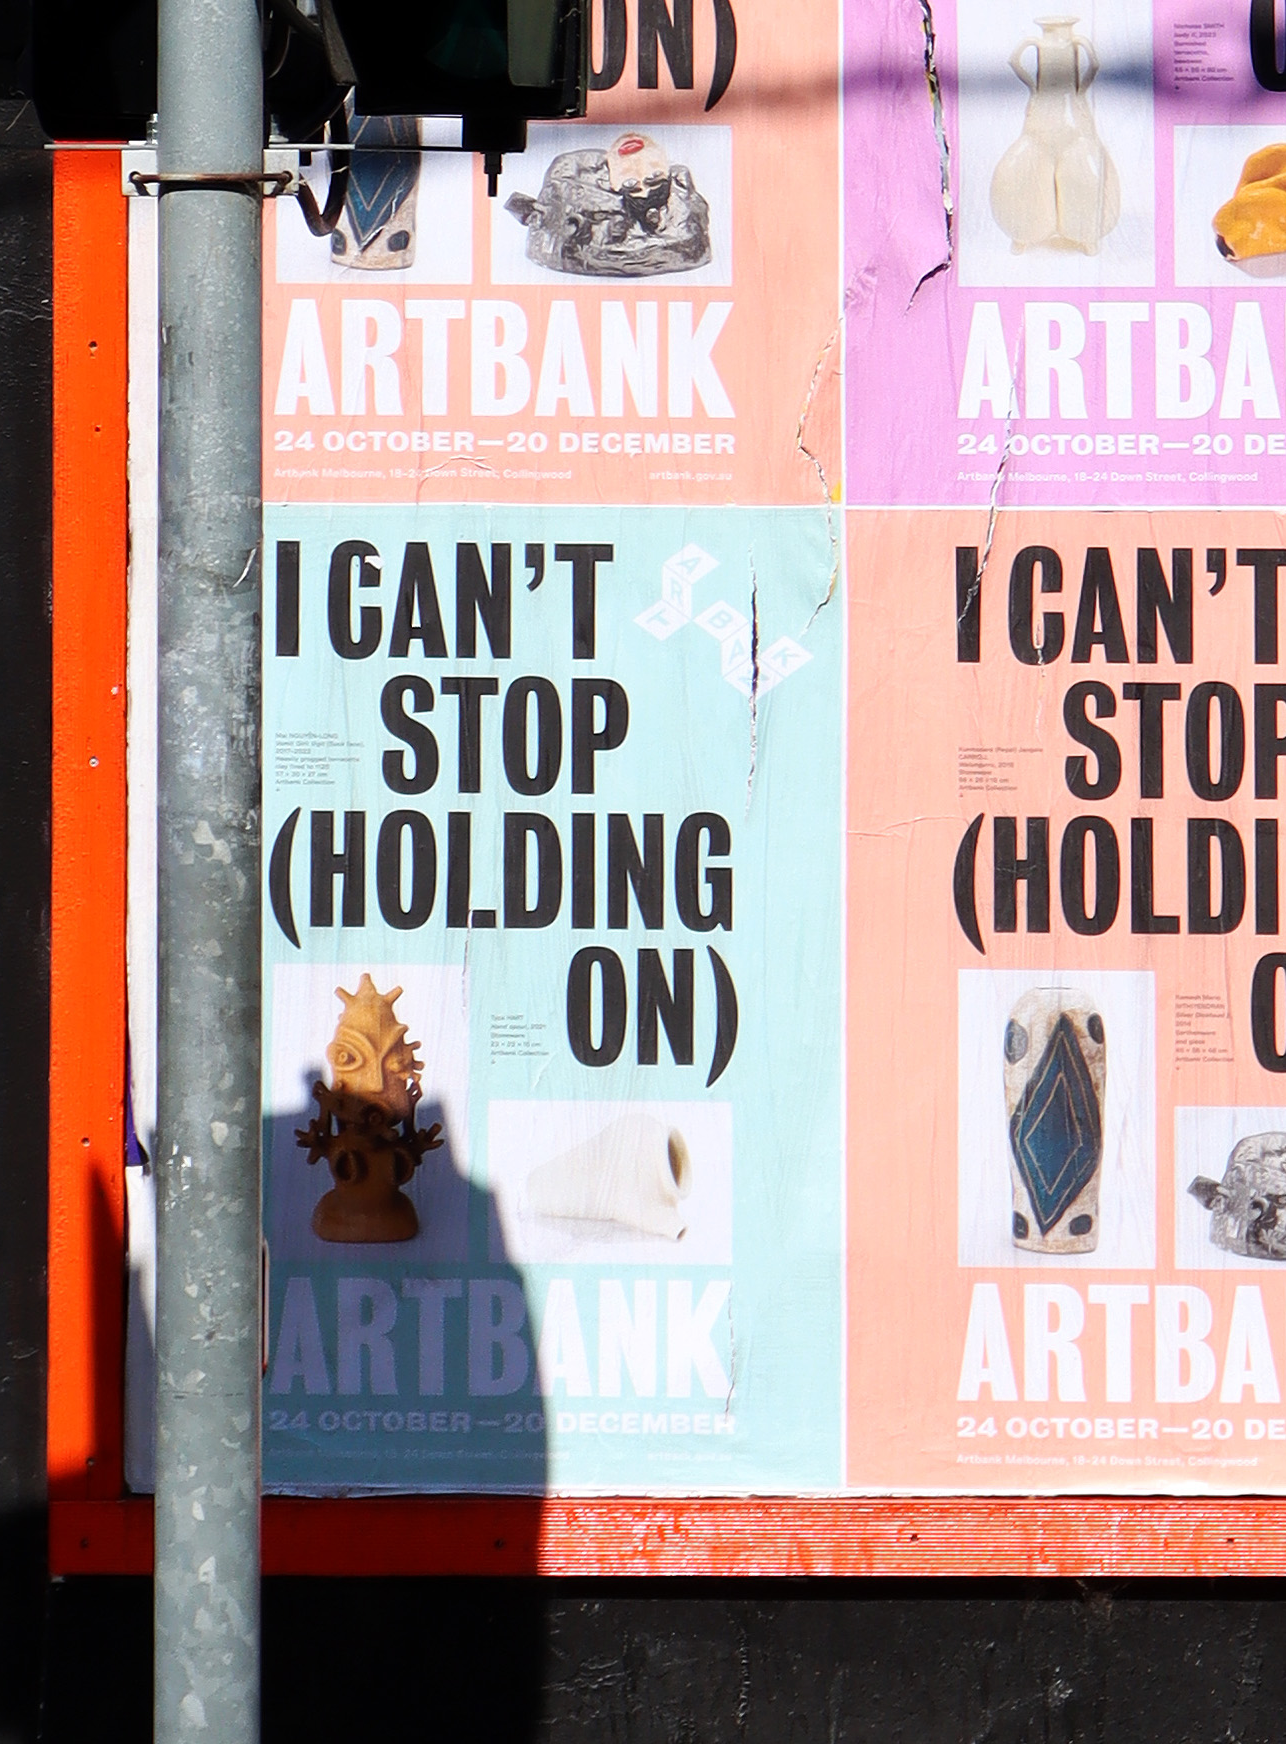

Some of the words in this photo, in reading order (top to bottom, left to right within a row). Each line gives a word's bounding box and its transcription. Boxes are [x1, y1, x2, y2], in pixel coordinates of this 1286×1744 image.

[275, 299, 736, 418] ARTBANK
[275, 430, 315, 451] 24
[560, 432, 735, 457] DECEMBER
[958, 434, 998, 454] 24
[322, 468, 386, 479] Melbourne,
[503, 469, 571, 481] Collingwood
[649, 470, 732, 482] artbank.gov.au
[1009, 472, 1071, 484] Melbourne,
[1074, 472, 1108, 481] 18–24
[1111, 472, 1143, 481] Down
[1146, 472, 1185, 483] Street,
[1189, 472, 1258, 484] Collingwood
[276, 541, 300, 656] I
[328, 540, 613, 660] CAN'T
[956, 547, 983, 662] I
[381, 675, 629, 796] STOP
[269, 807, 733, 949] (HOLDING
[567, 945, 738, 1087] ON)
[269, 1277, 731, 1397] ARTBANK
[268, 1410, 311, 1431] 24
[556, 1412, 734, 1434] DECEMBER
[957, 1416, 998, 1437] 24
[957, 1455, 1002, 1464] Artbank
[1005, 1455, 1069, 1467] Melbourne,
[1110, 1456, 1142, 1465] Down
[1145, 1456, 1185, 1468] Street,
[1188, 1456, 1258, 1469] Collingwood
